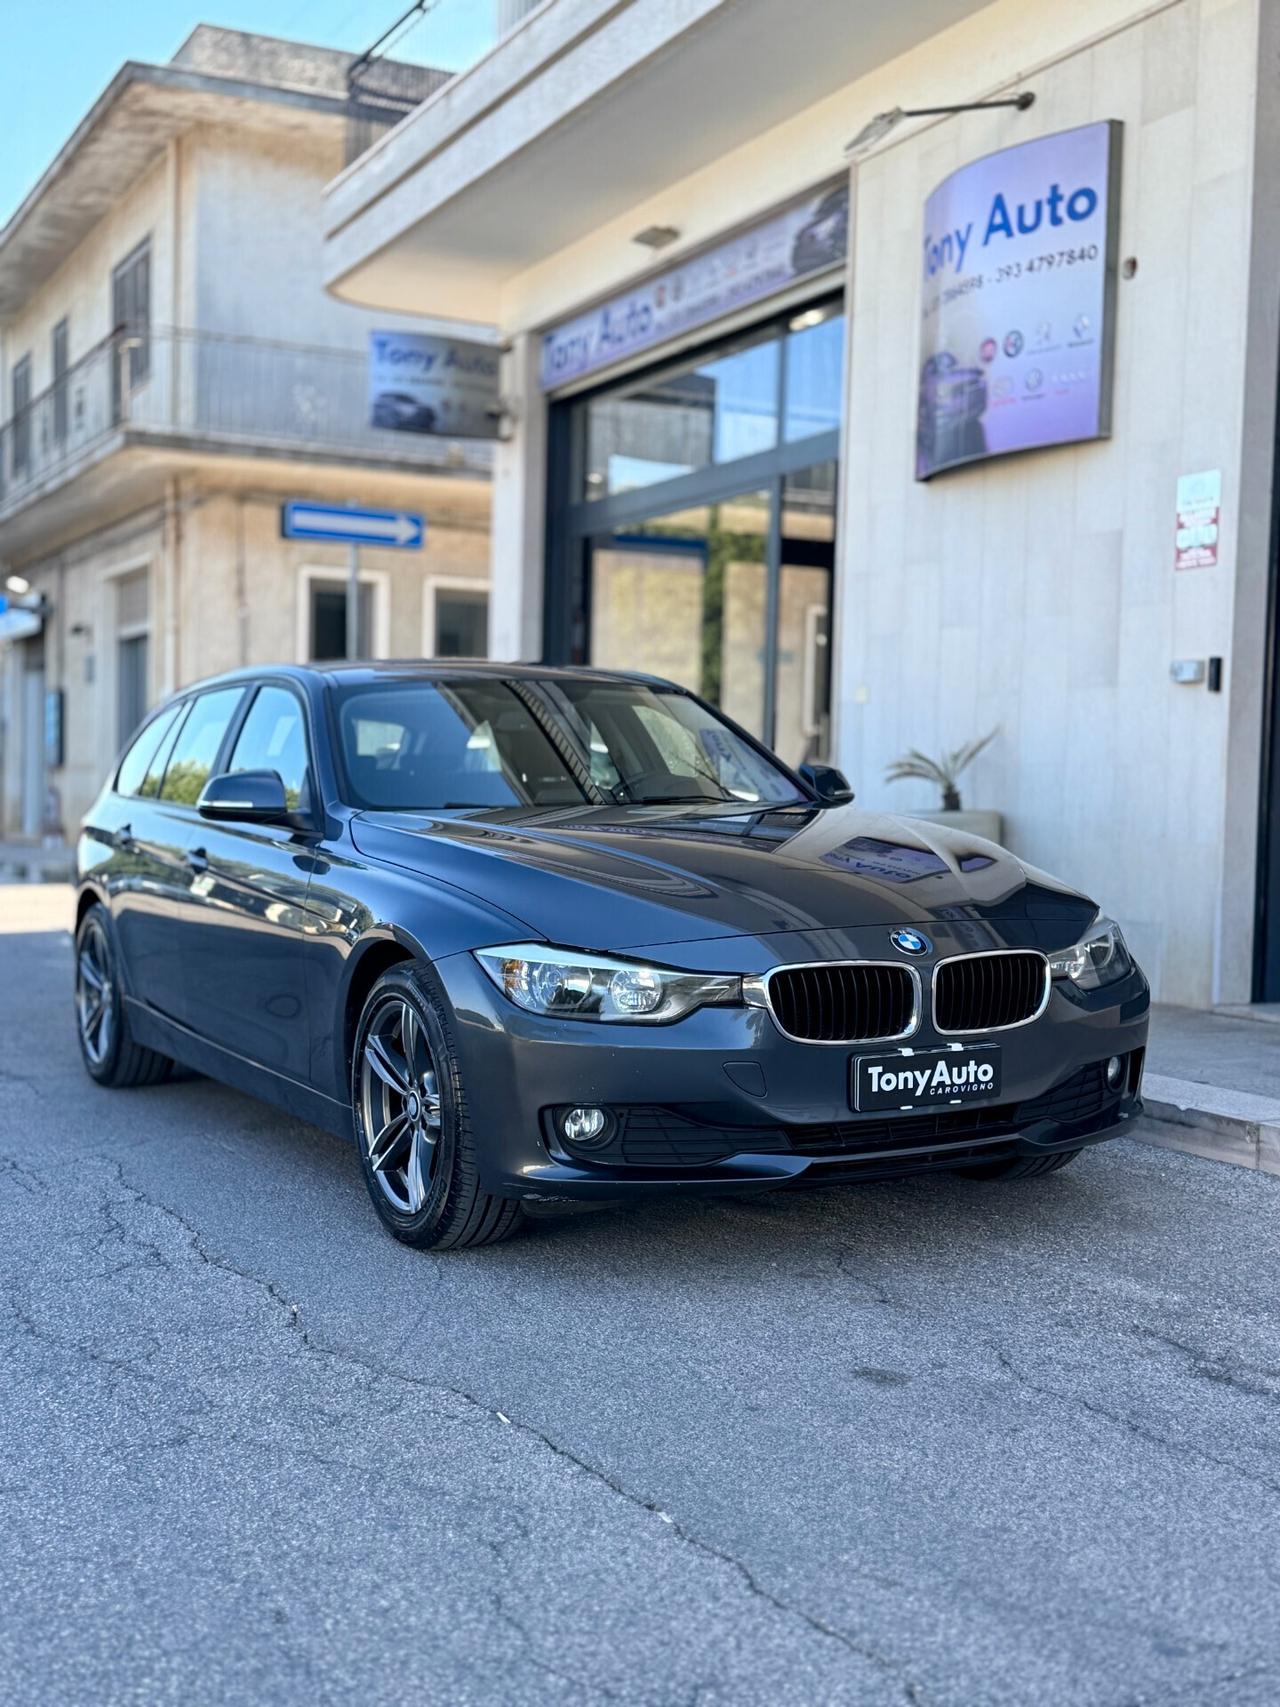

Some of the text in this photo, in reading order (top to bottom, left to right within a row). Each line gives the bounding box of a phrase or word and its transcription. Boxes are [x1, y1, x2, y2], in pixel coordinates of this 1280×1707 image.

[982, 184, 1098, 247] Auto
[373, 338, 438, 372] Tony
[867, 1060, 994, 1097] TonyAuto
[929, 1082, 994, 1096] CAROVIGNO
